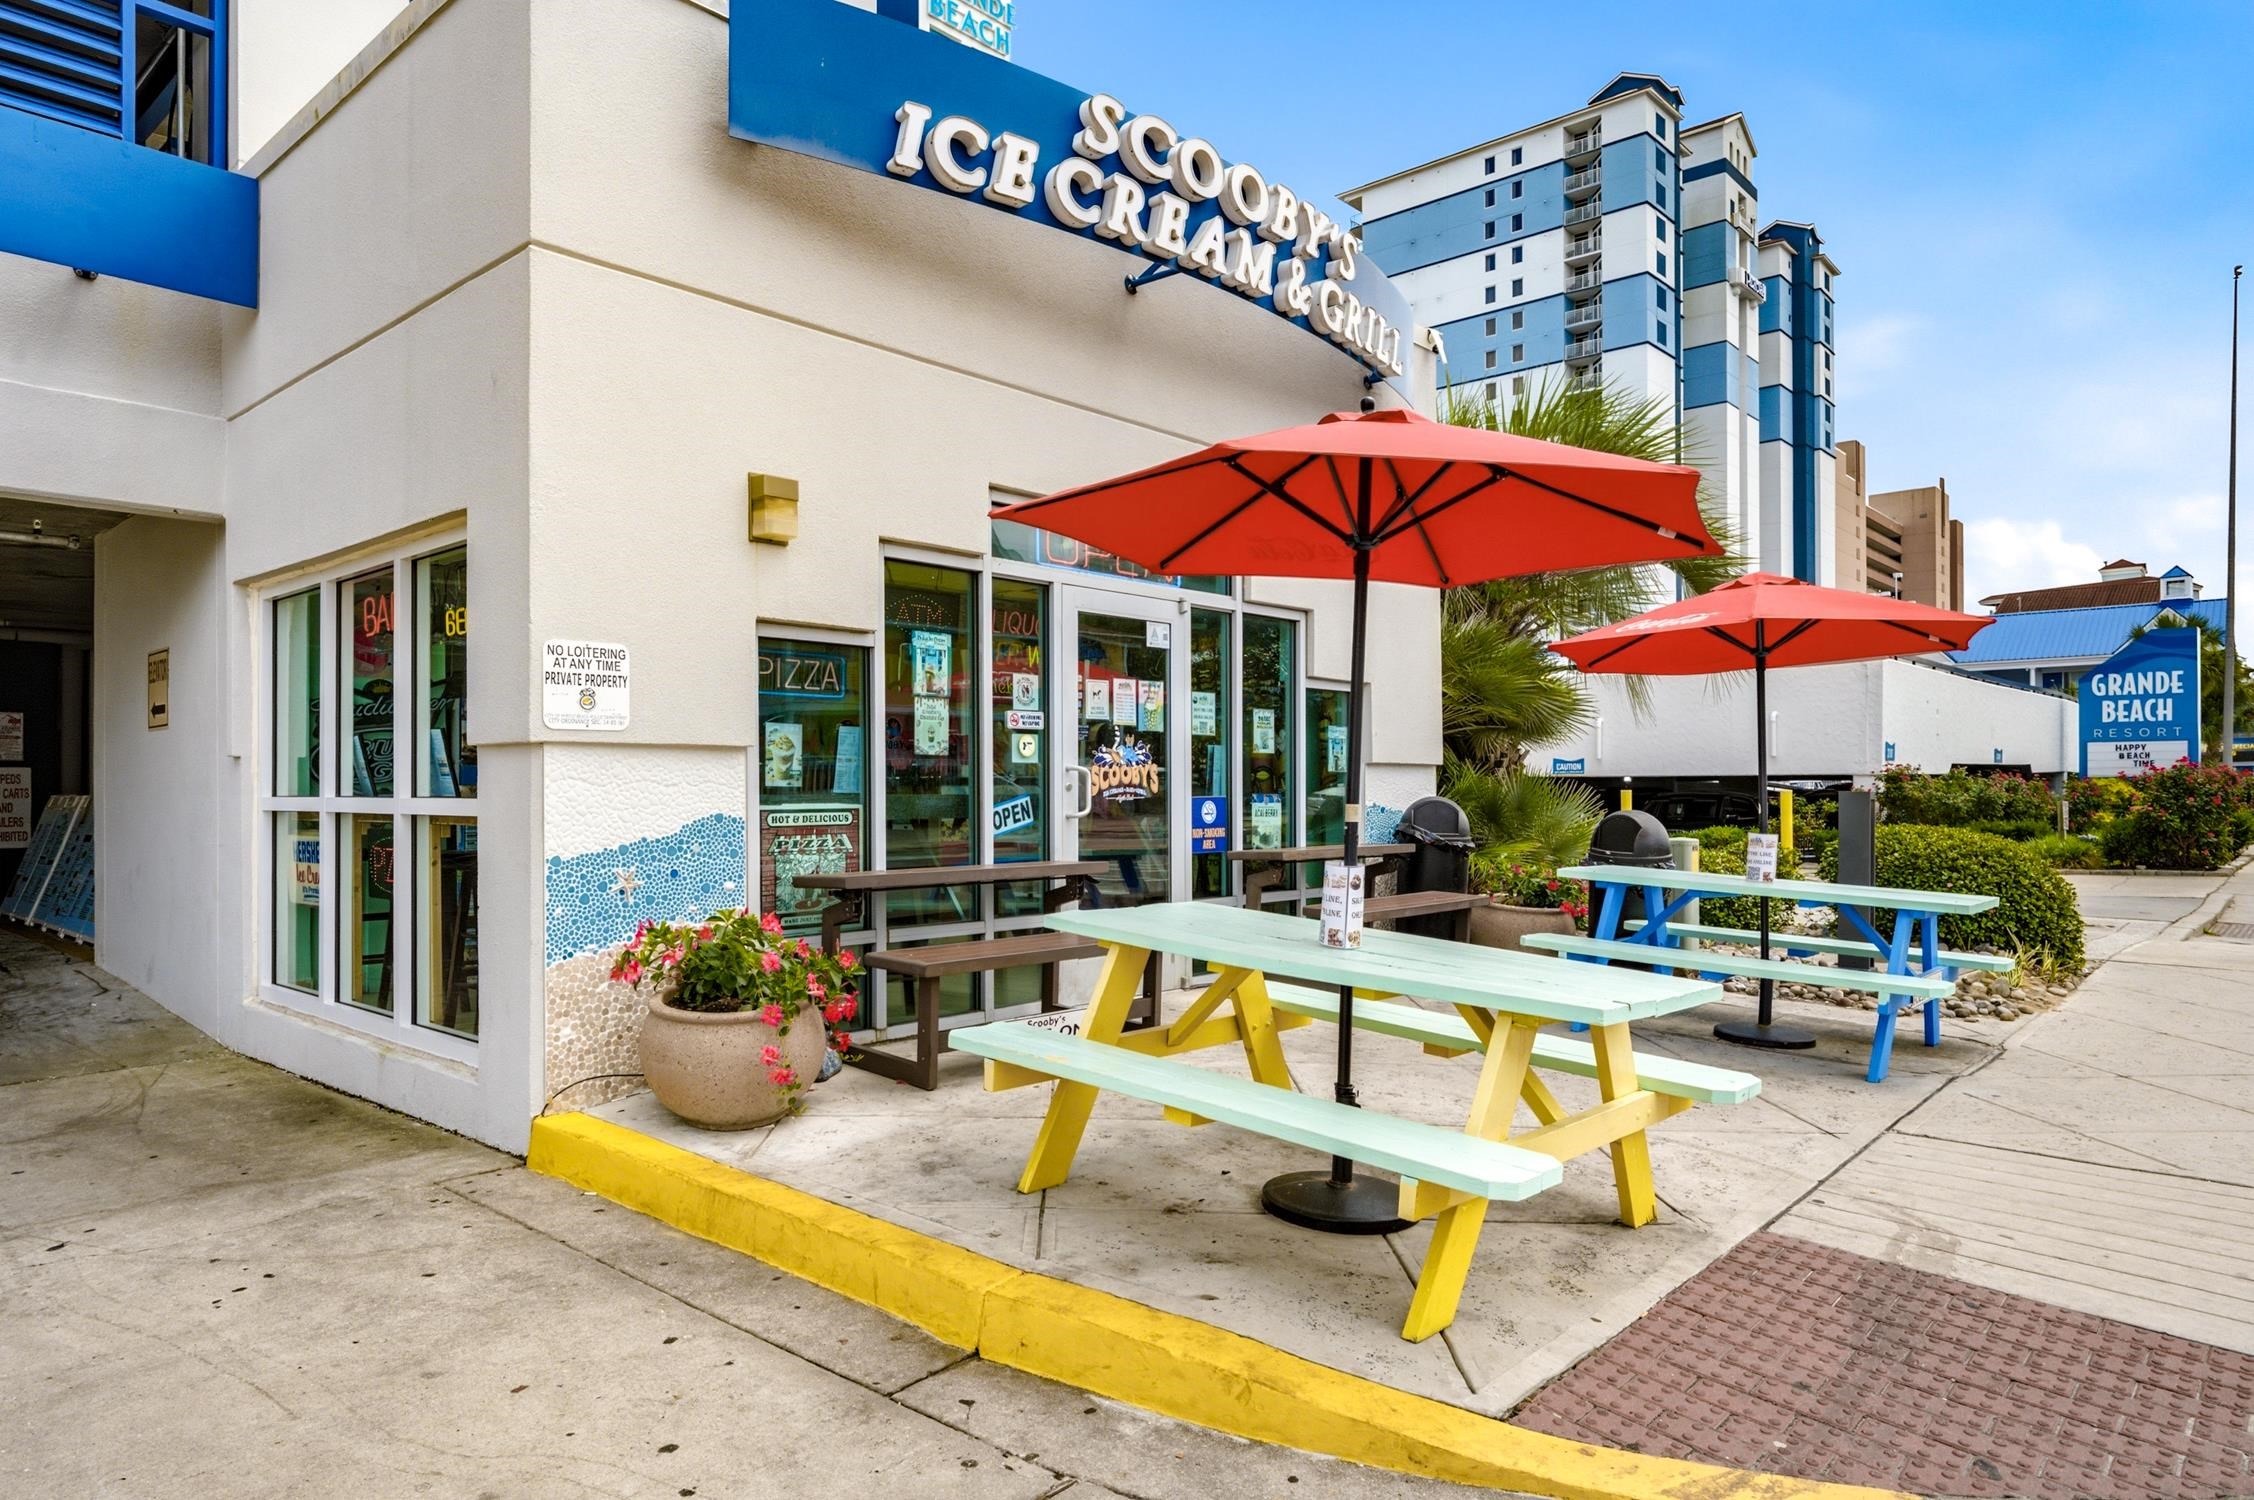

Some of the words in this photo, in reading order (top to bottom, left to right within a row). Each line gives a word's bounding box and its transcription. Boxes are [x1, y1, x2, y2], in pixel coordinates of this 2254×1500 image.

[929, 0, 1010, 55] BEACH
[1073, 93, 1362, 282] SCOOBY'S
[886, 100, 1040, 208] ICE
[1045, 157, 1274, 298] CREAM
[1274, 256, 1313, 317] &
[1308, 279, 1403, 377] GRILL
[363, 592, 394, 637] BA
[896, 603, 942, 626] ATM
[547, 644, 564, 656] NO
[567, 645, 626, 660] LOITERING
[553, 657, 567, 668] AT
[569, 658, 592, 670] ANY
[595, 660, 621, 671] TIME
[545, 671, 582, 686] PRIVATE
[585, 673, 628, 688] PROPERTY
[759, 656, 839, 691] PIZZA
[2091, 670, 2184, 697] GRANDE
[2101, 698, 2173, 723] BEACH
[2093, 727, 2183, 738] RESORT
[2115, 743, 2147, 751] HAPPY
[2118, 752, 2150, 760] BEACH
[1556, 763, 1582, 771] CAUTION
[3, 788, 30, 799] CARTS
[771, 815, 790, 824] HOT
[792, 815, 799, 823] &
[802, 814, 849, 824] DELICIOUS
[993, 800, 1031, 830] OPEN
[1192, 827, 1226, 838] NON-SMOKING
[775, 837, 847, 850] PIZZA
[1203, 839, 1216, 850] AREA
